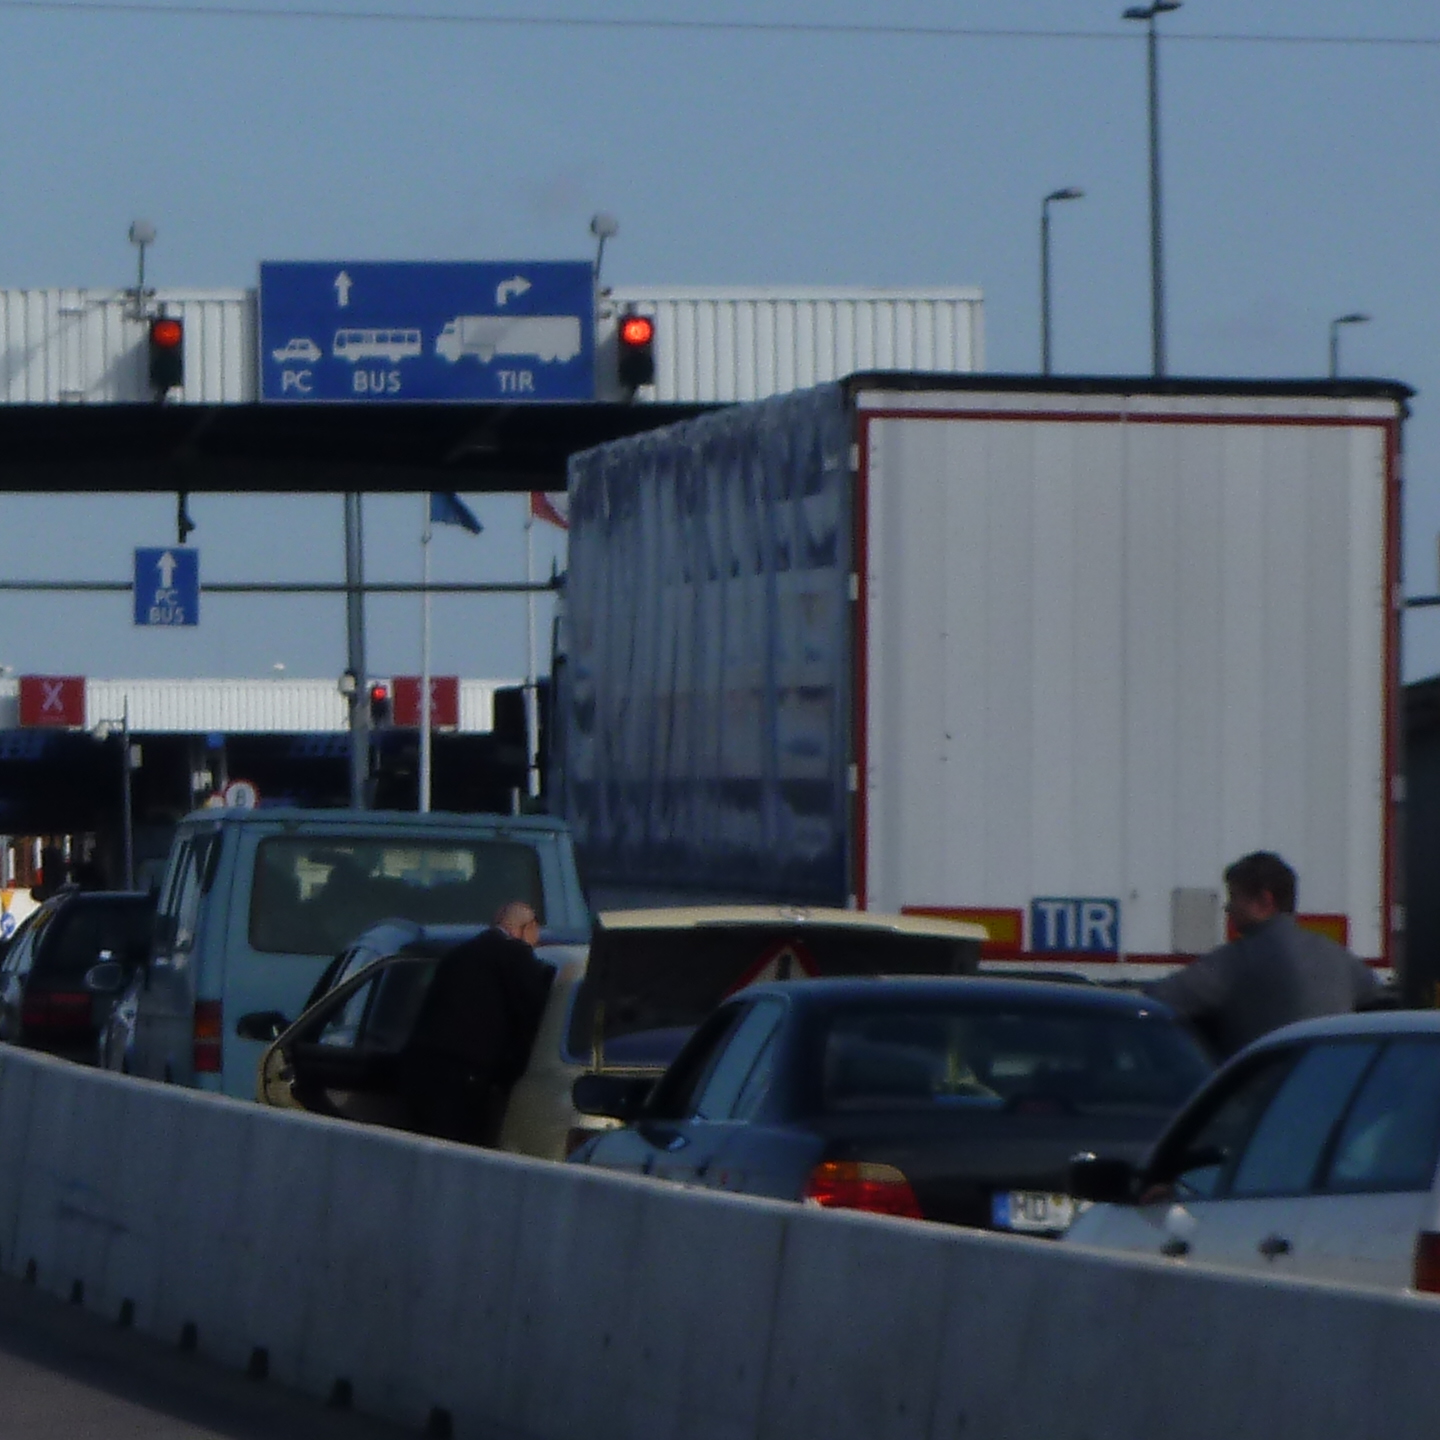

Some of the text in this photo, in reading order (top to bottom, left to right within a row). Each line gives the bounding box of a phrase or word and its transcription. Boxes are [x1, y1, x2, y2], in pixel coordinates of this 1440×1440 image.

[282, 370, 535, 392] PC BUS TIR
[149, 606, 184, 624] BUS
[1037, 902, 1113, 949] TIR
